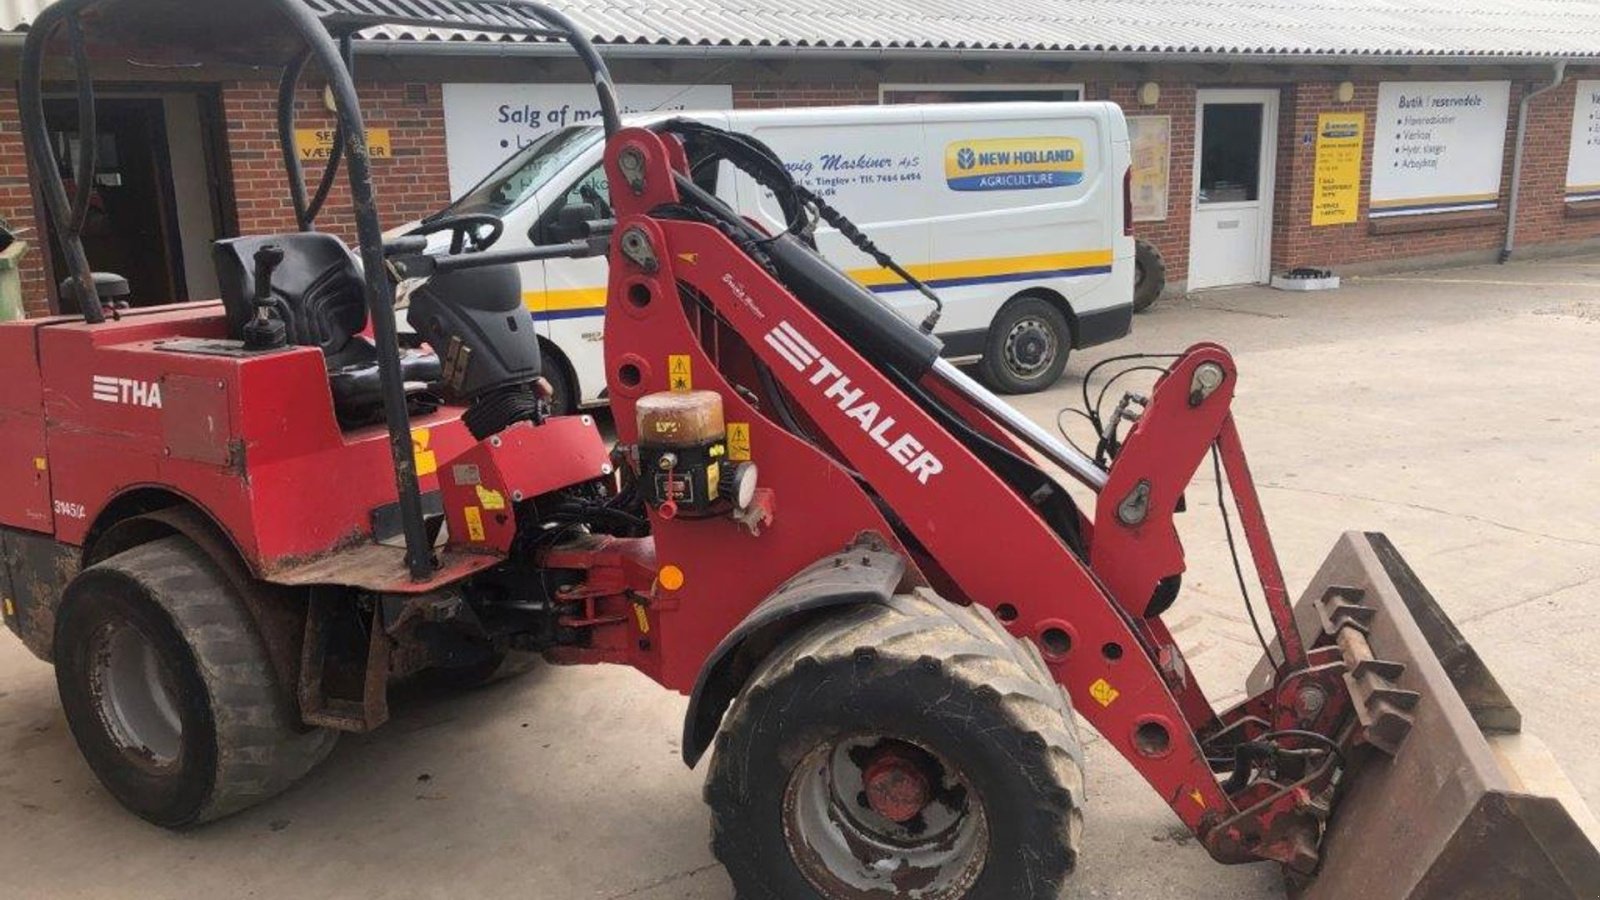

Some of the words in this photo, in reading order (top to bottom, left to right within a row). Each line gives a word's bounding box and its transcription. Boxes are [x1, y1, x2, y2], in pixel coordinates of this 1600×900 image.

[498, 105, 541, 128] Salg
[547, 105, 570, 127] af
[820, 154, 892, 171] Maskiner
[978, 152, 1009, 166] NEW
[1014, 149, 1075, 165] HOLLAND
[979, 173, 1054, 187] AGRICULTURE
